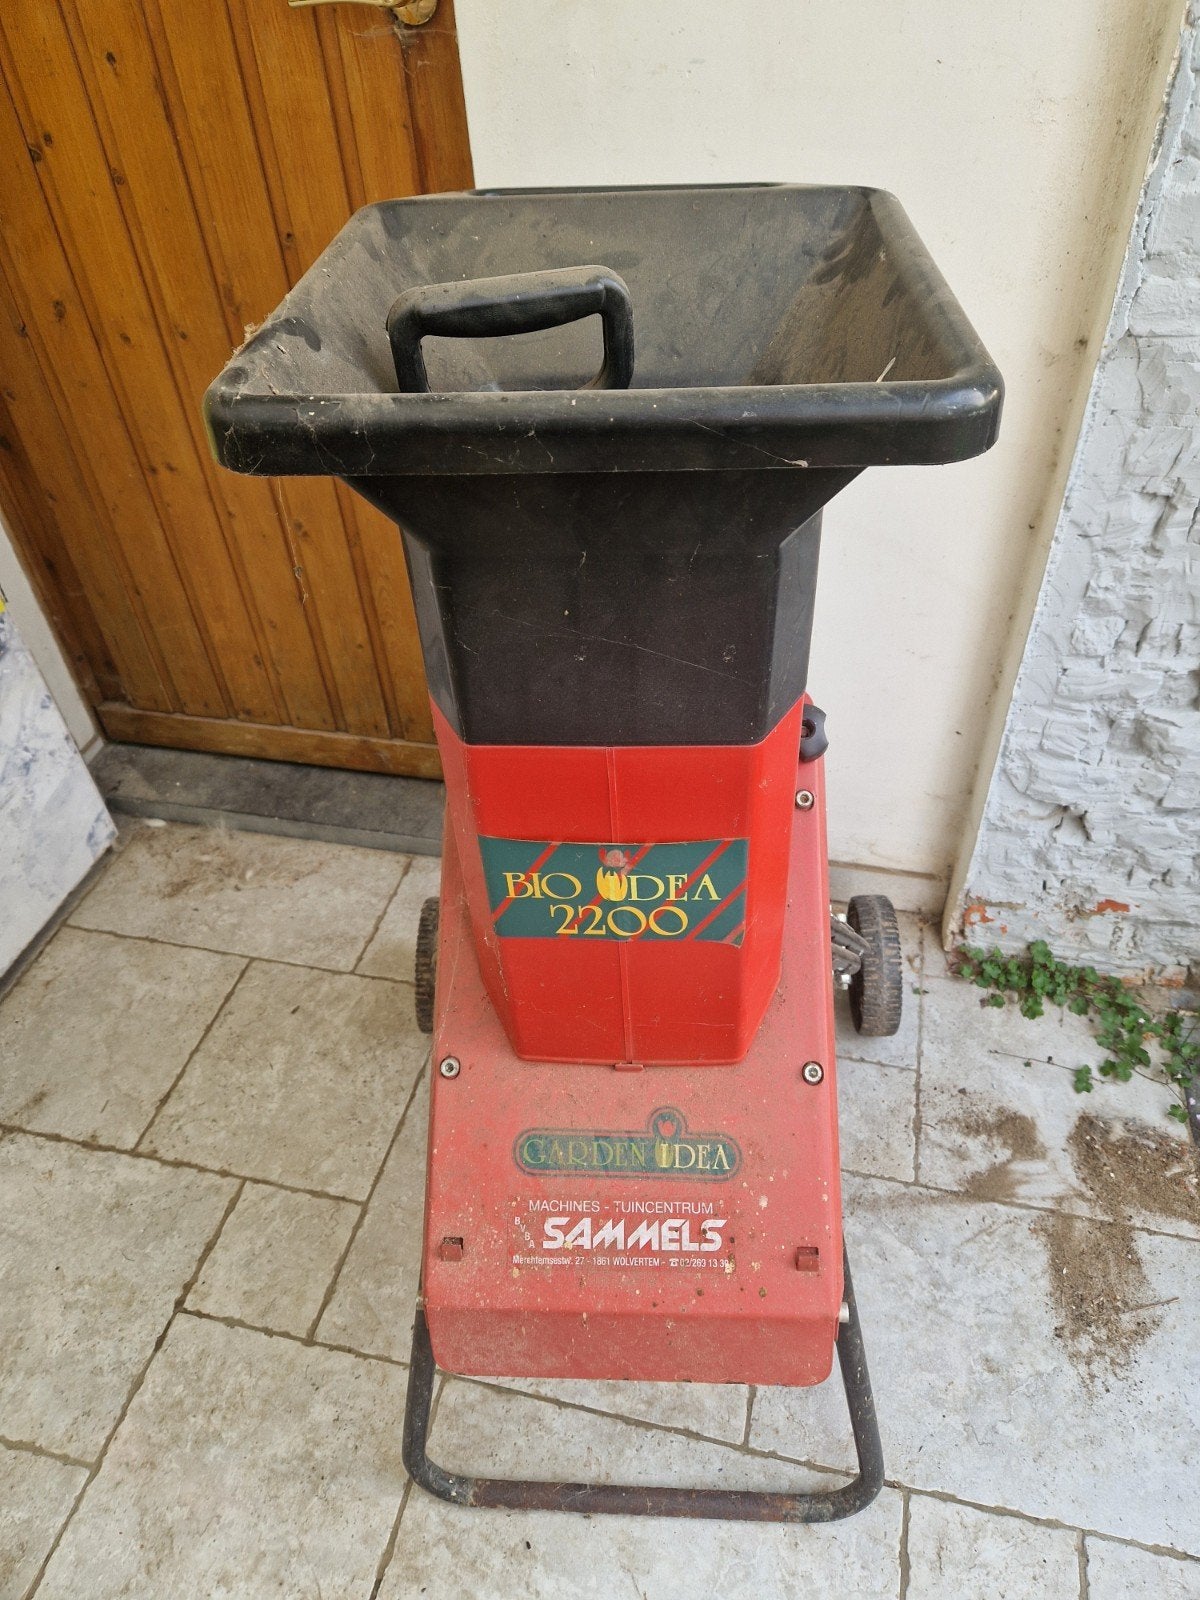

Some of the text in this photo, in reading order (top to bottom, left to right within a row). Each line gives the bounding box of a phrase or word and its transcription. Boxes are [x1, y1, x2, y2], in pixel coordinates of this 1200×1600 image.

[502, 872, 722, 902] BIO IDEA
[549, 904, 689, 937] 2200
[523, 1139, 731, 1170] GARDEN IDEA
[528, 1199, 600, 1212] MACHINES
[615, 1200, 713, 1214] TUINCENTRUM
[542, 1216, 728, 1252] SAMMELS
[575, 1256, 585, 1265] 27
[592, 1256, 610, 1266] 1861
[612, 1256, 660, 1267] WOLVERTEM
[709, 1259, 718, 1268] 13
